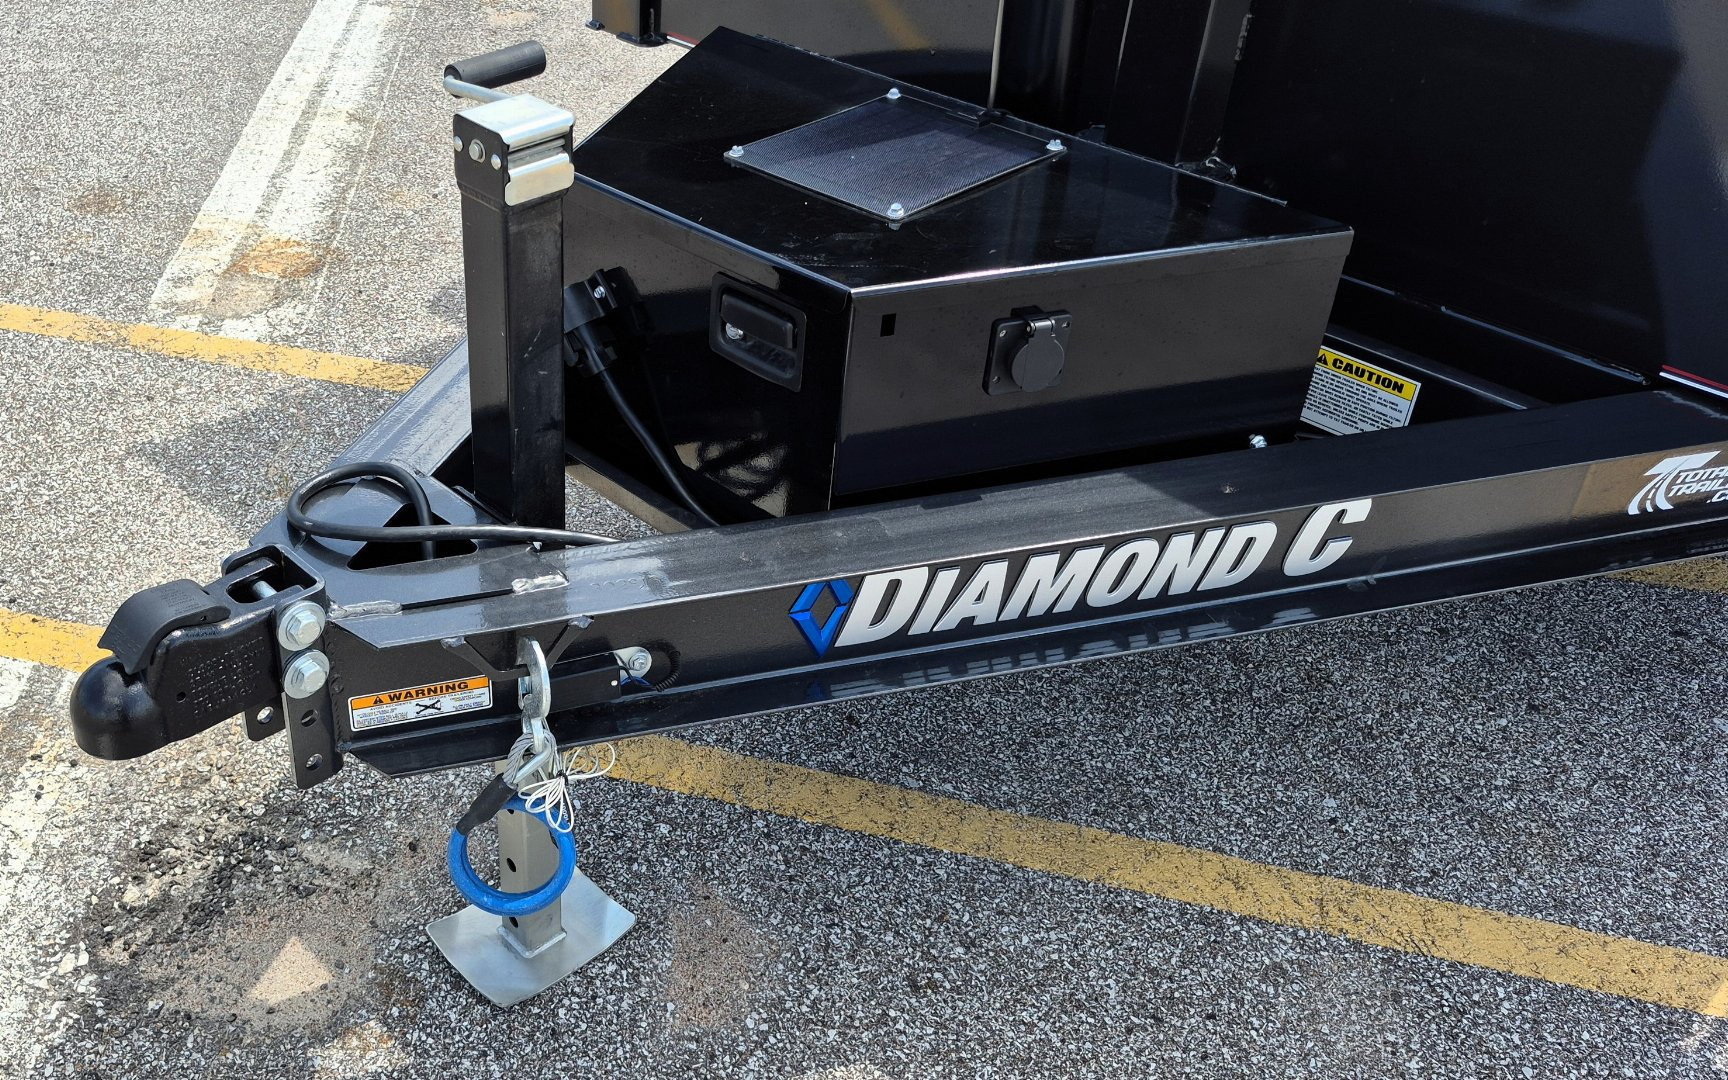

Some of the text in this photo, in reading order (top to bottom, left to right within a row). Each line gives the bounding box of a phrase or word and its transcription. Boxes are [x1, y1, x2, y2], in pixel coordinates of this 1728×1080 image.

[1332, 358, 1404, 394] CAUTION
[1667, 478, 1728, 497] TRAIL
[1706, 490, 1728, 504] .C
[833, 498, 1373, 647] DIAMOND C
[388, 681, 469, 702] WARNING
